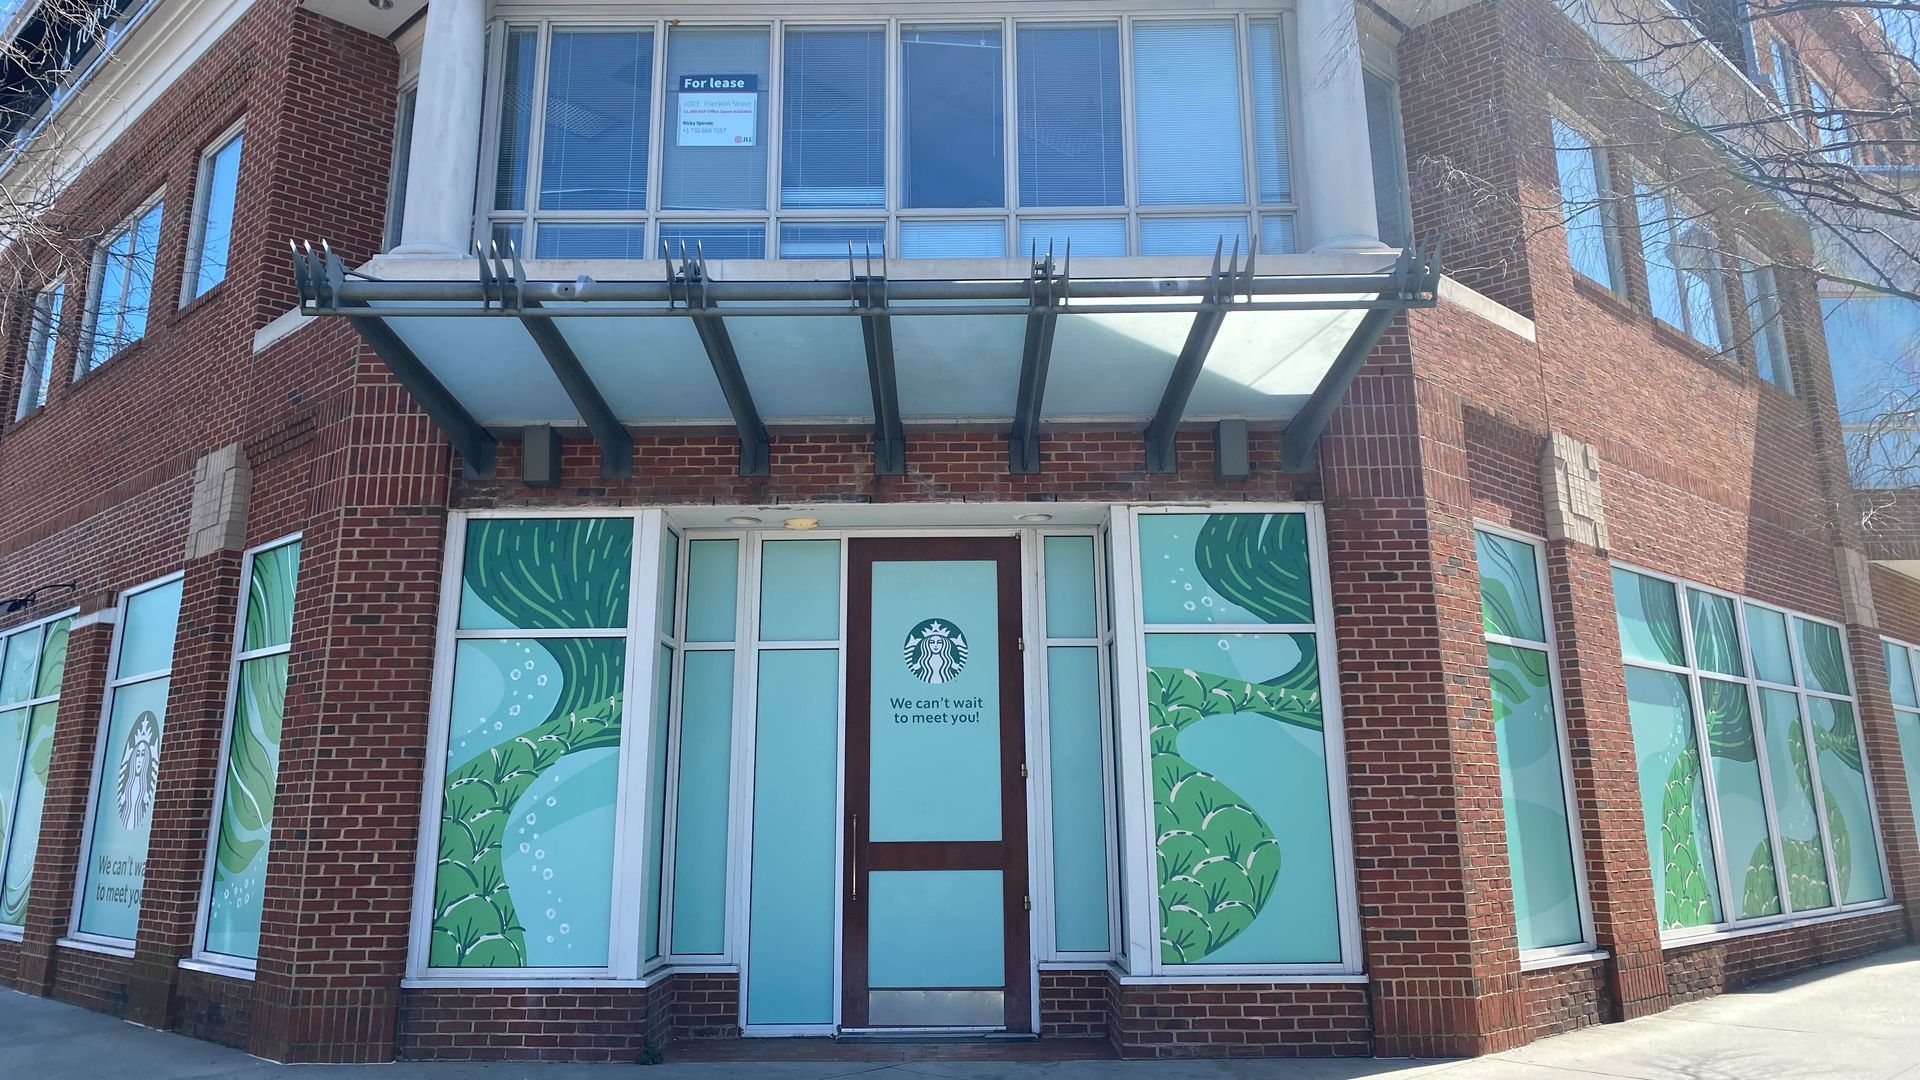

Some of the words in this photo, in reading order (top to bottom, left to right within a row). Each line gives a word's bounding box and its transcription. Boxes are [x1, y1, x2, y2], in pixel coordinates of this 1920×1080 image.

[684, 78, 707, 89] For
[709, 77, 745, 89] lease
[890, 697, 912, 709] We
[915, 697, 950, 709] can't
[953, 697, 983, 709] wait
[894, 713, 908, 724] to
[912, 712, 948, 724] meet
[951, 711, 980, 726] you!
[99, 855, 111, 875] We
[135, 860, 146, 877] wa
[96, 882, 105, 901] to
[106, 884, 128, 904] meet
[127, 889, 140, 909] yo
